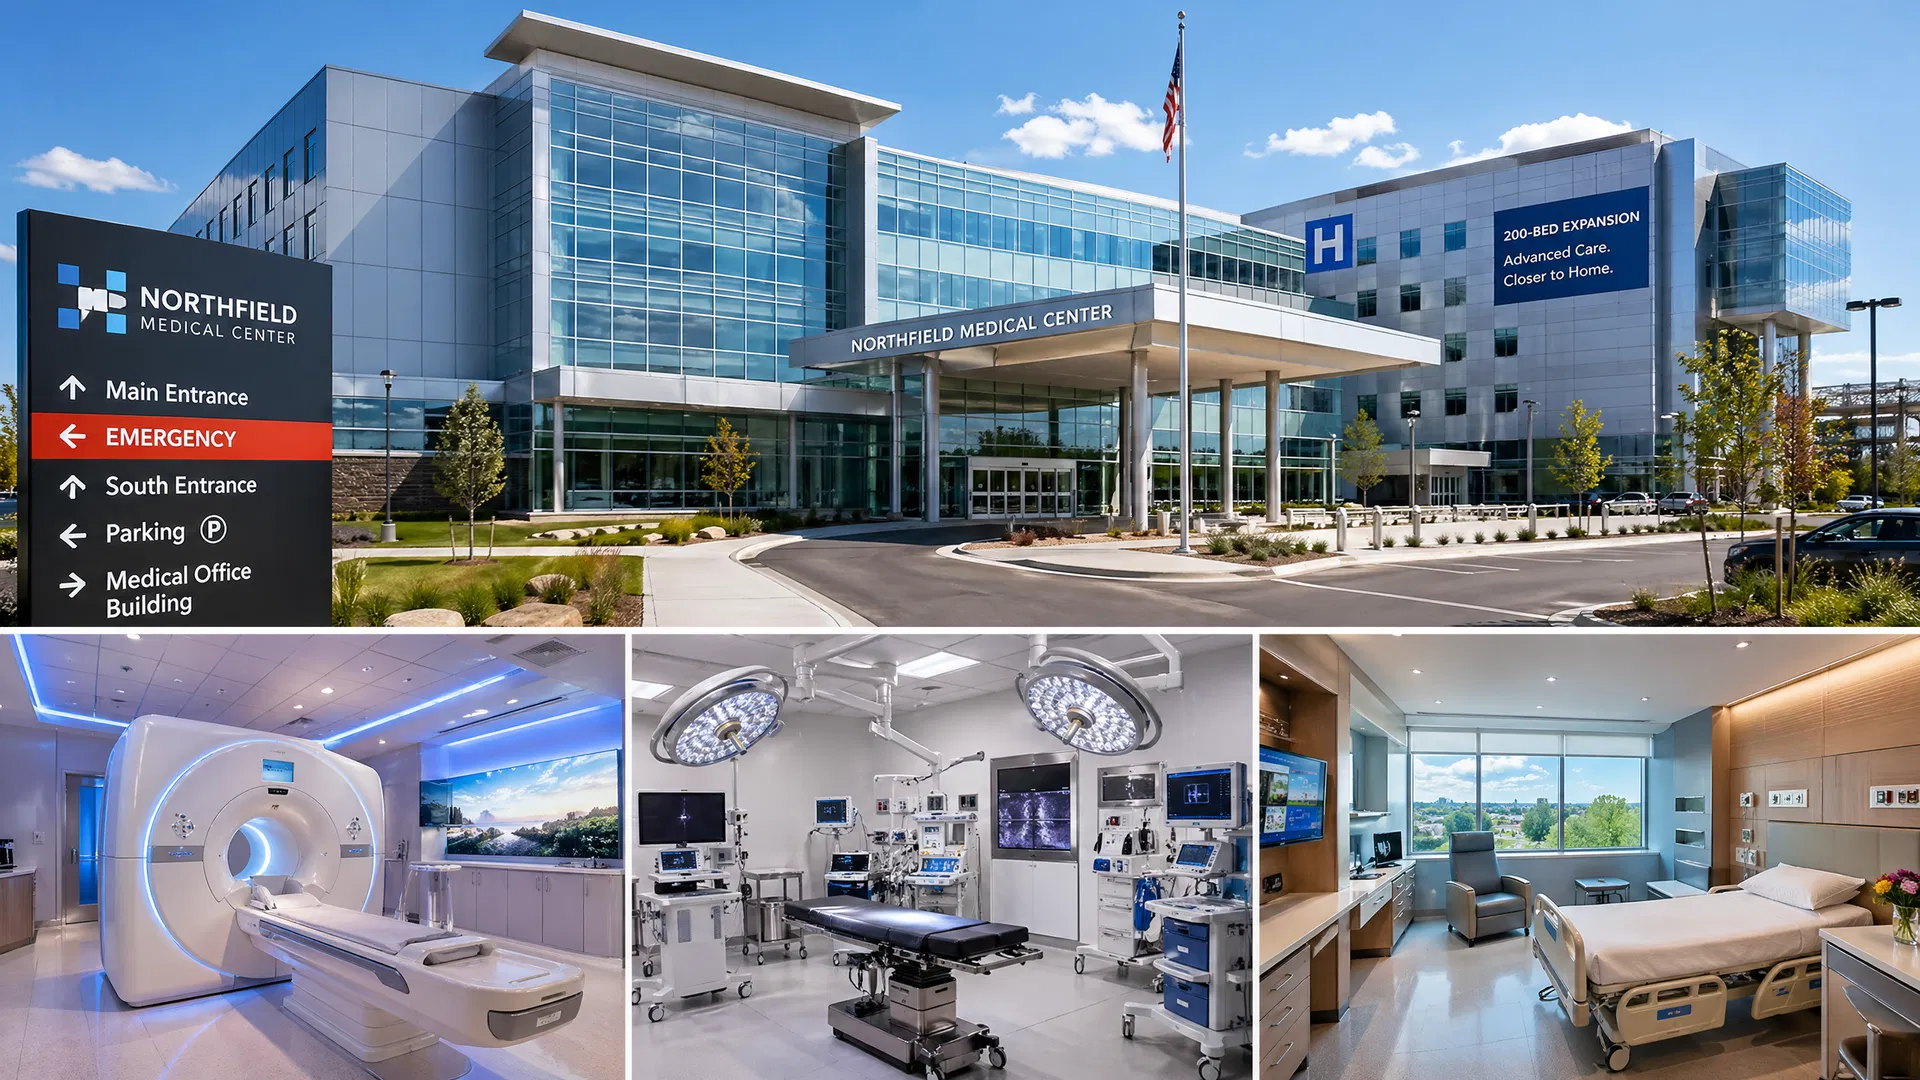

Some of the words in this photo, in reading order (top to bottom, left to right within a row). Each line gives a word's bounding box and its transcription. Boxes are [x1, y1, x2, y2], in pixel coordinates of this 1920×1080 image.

[1503, 223, 1559, 242] 200-BED
[1562, 210, 1640, 233] EXPANSION
[1314, 224, 1344, 265] H
[1503, 248, 1571, 267] Advanced
[1575, 243, 1611, 257] Care.
[1503, 271, 1547, 287] Closer
[1550, 270, 1565, 281] to
[1568, 264, 1614, 279] Home.
[140, 286, 298, 325] NORTHFIELD
[140, 315, 224, 338] MEDICAL
[231, 325, 296, 345] CENTER
[851, 326, 954, 353] NORTHFIELD
[960, 315, 1038, 339] MEDICAL
[1043, 304, 1112, 328] CENTER
[106, 379, 159, 402] Main
[165, 383, 249, 406] Entrance
[106, 427, 237, 448] EMERGENCY
[106, 474, 169, 496] South
[175, 476, 257, 495] Entrance
[106, 521, 186, 546] Parking
[106, 564, 188, 591] Medical
[194, 562, 252, 585] Office
[106, 593, 192, 619] Building
